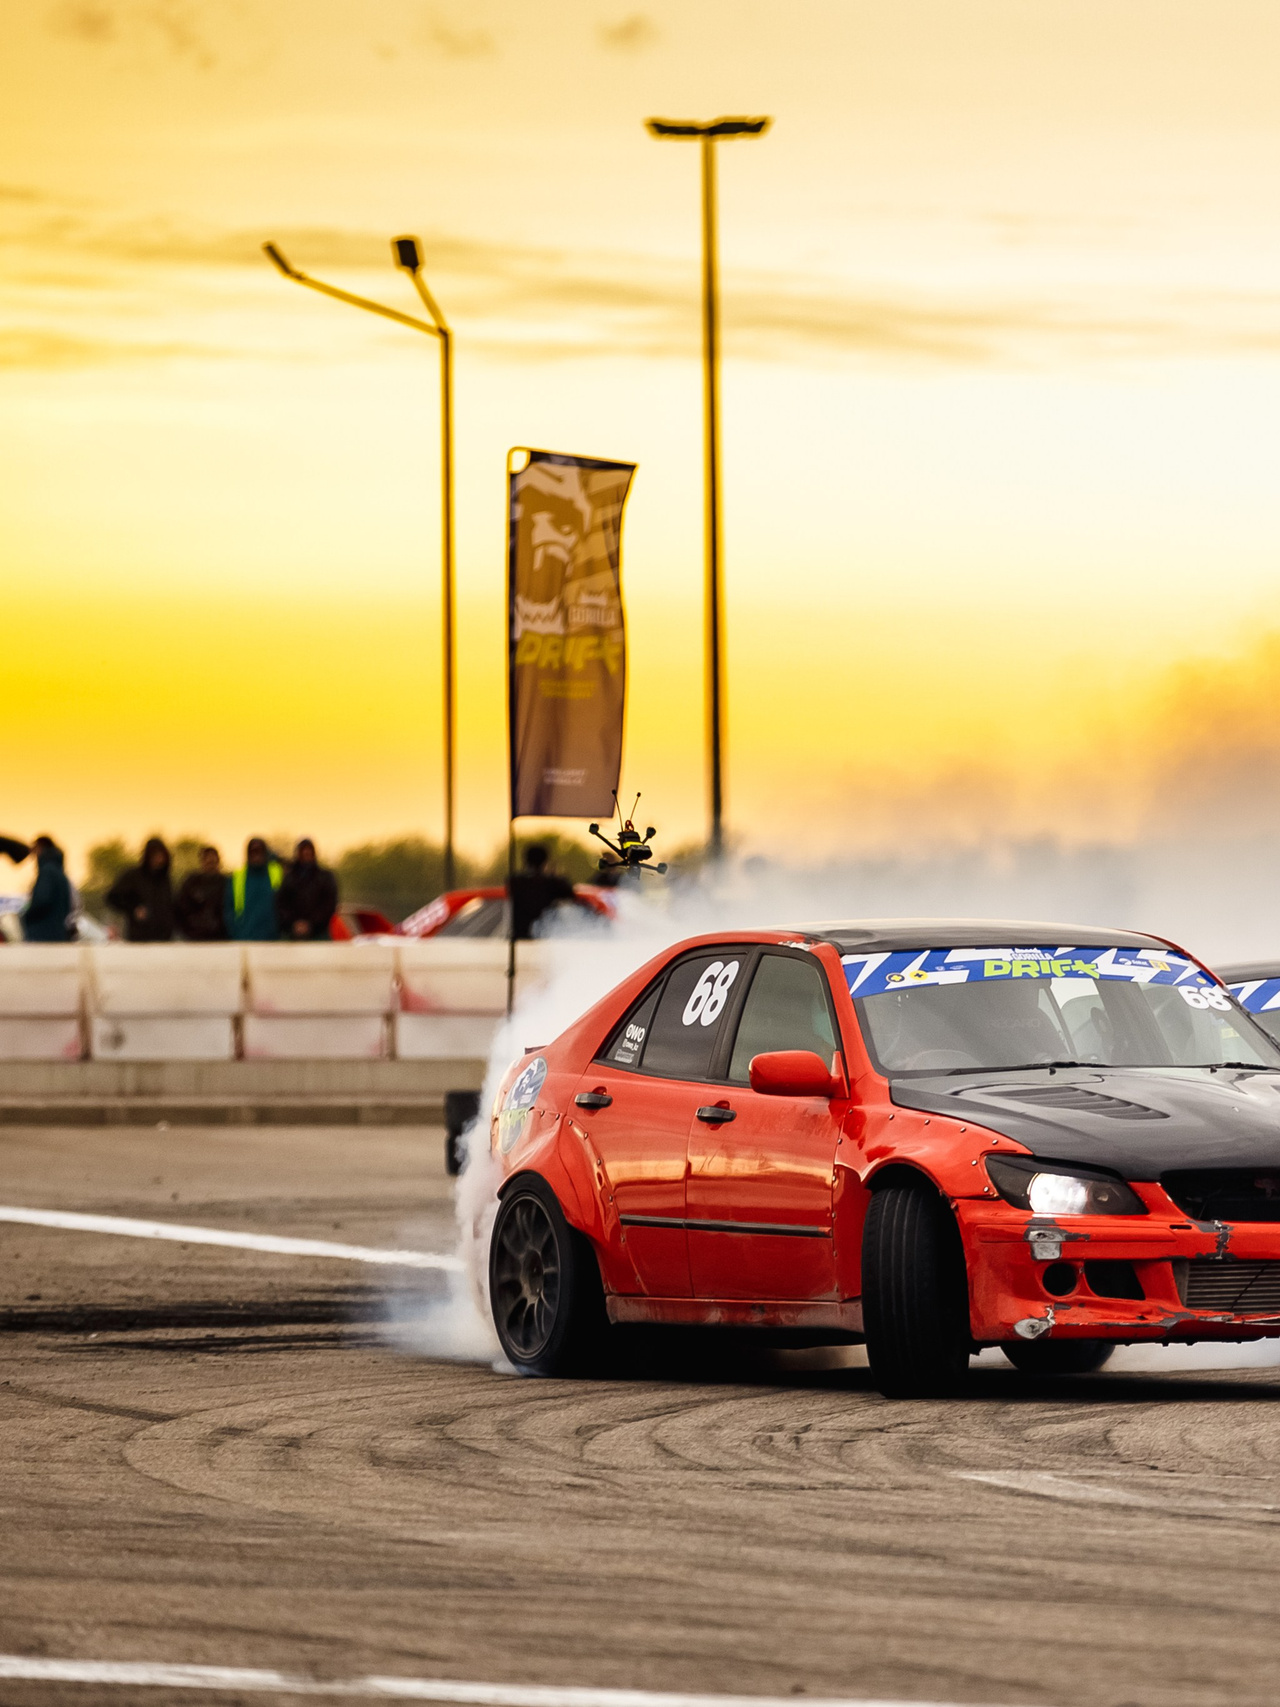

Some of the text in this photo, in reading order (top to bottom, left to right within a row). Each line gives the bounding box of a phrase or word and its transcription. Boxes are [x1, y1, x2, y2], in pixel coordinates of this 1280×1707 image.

[515, 630, 622, 675] DRIFT
[682, 960, 740, 1027] 68
[1177, 985, 1232, 1012] 68
[625, 1023, 646, 1043] OWO
